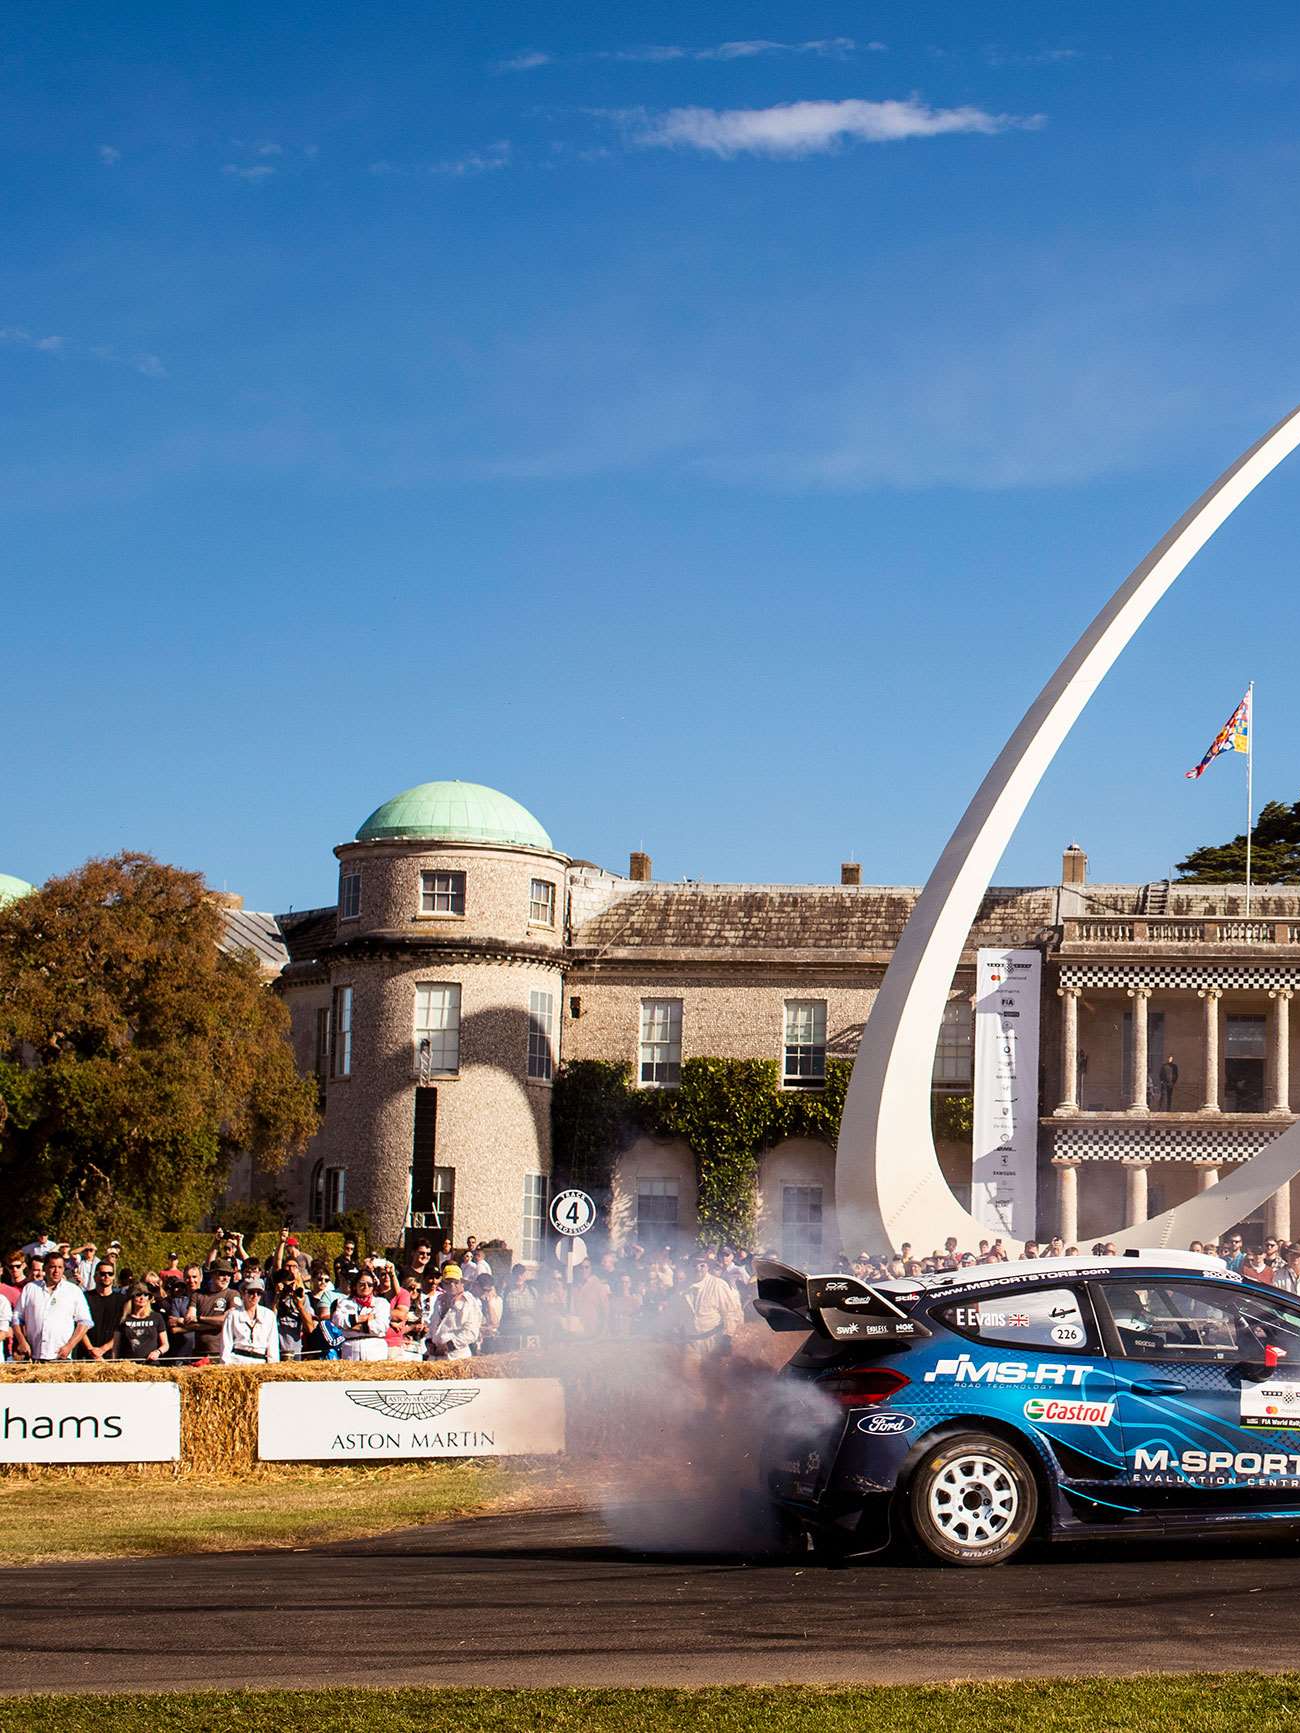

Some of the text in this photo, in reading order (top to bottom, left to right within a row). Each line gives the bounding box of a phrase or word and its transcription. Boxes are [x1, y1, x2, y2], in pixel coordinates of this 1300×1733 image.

[566, 1201, 579, 1224] 4
[929, 1267, 1111, 1300] www.MSPORTSTORE.com
[956, 1308, 1006, 1327] E Evans
[1057, 1329, 1077, 1340] 226
[955, 1360, 1094, 1386] MS-RT
[987, 1383, 1053, 1391] TECHNOLOGY
[1045, 1402, 1108, 1423] Castrol
[4, 1407, 123, 1440] hams
[868, 1415, 905, 1432] Ford
[331, 1430, 495, 1450] ASTON MARTIN
[1133, 1474, 1237, 1485] EVALUATION
